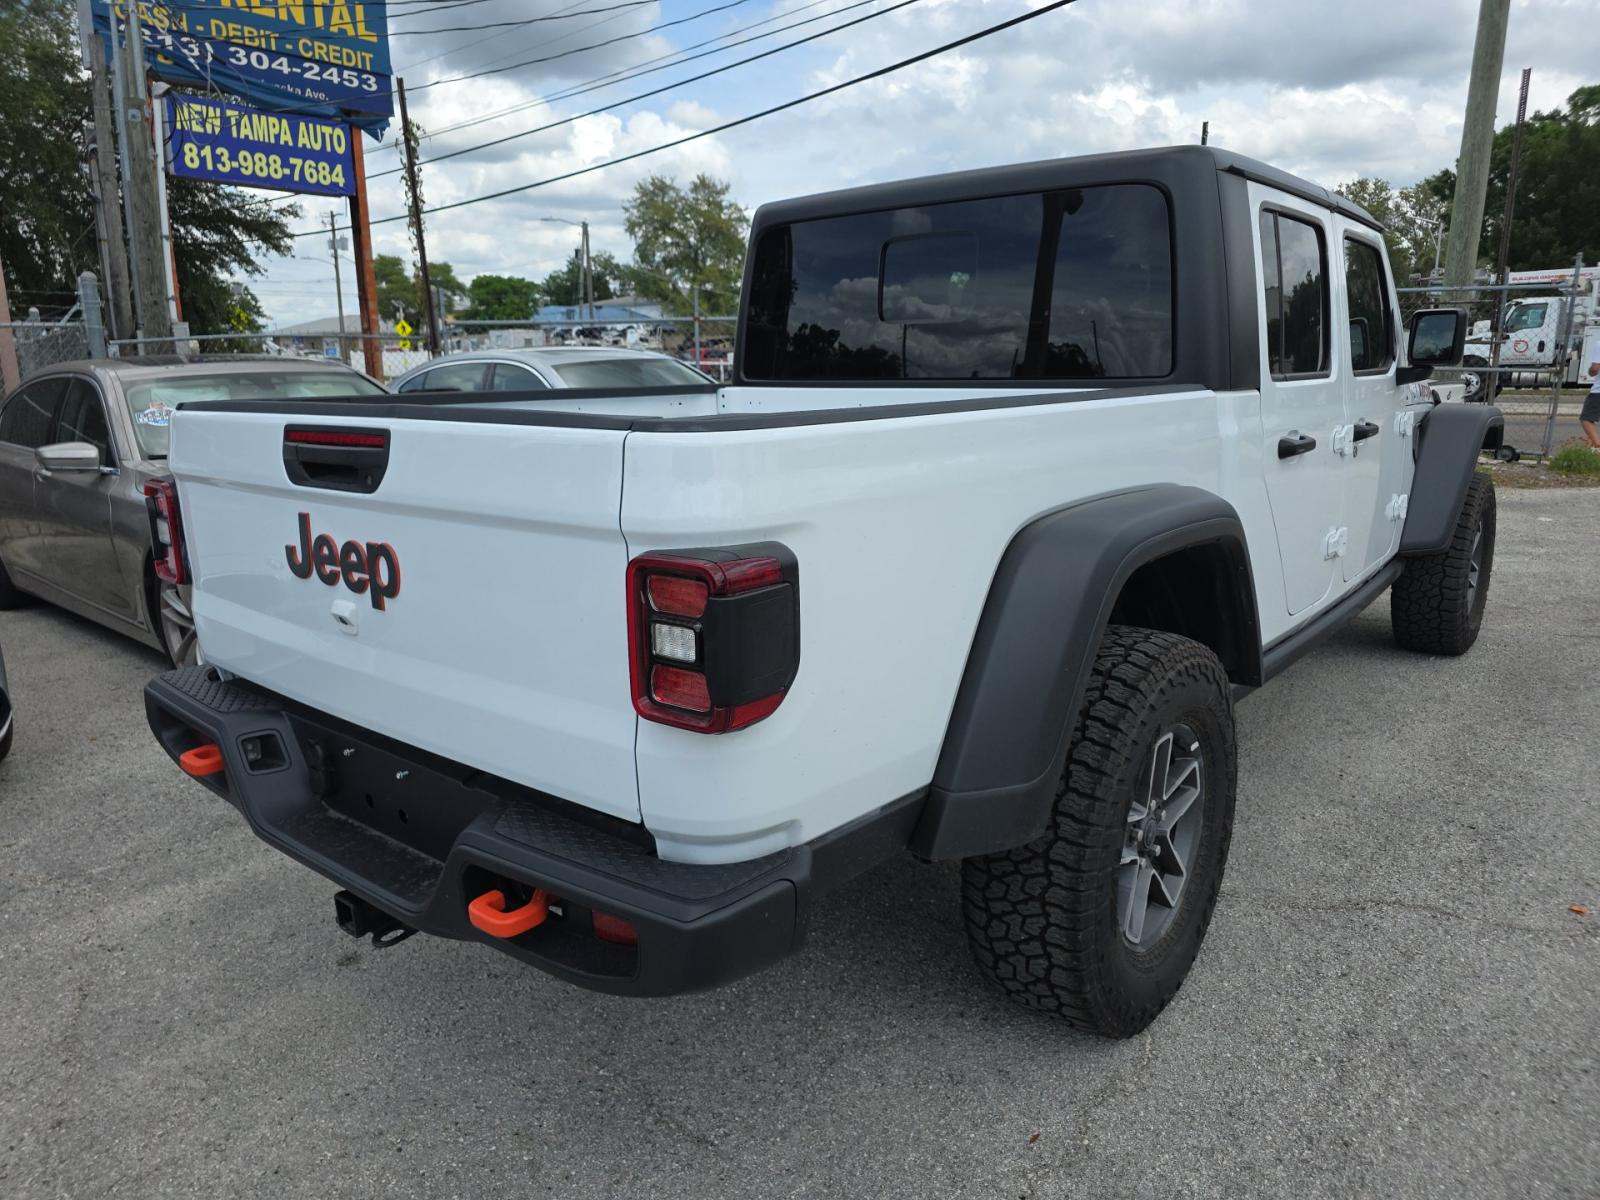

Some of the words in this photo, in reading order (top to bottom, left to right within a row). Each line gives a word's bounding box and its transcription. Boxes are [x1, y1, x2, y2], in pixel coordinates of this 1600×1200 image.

[209, 18, 279, 51] DEBIT
[298, 38, 374, 72] CREDIT
[228, 46, 379, 93] 304-2453
[176, 102, 222, 136] NEW
[226, 109, 294, 147] TAMPA
[297, 121, 347, 156] AUTO
[183, 142, 346, 188] 813-988-7684
[285, 511, 401, 612] Jeep
